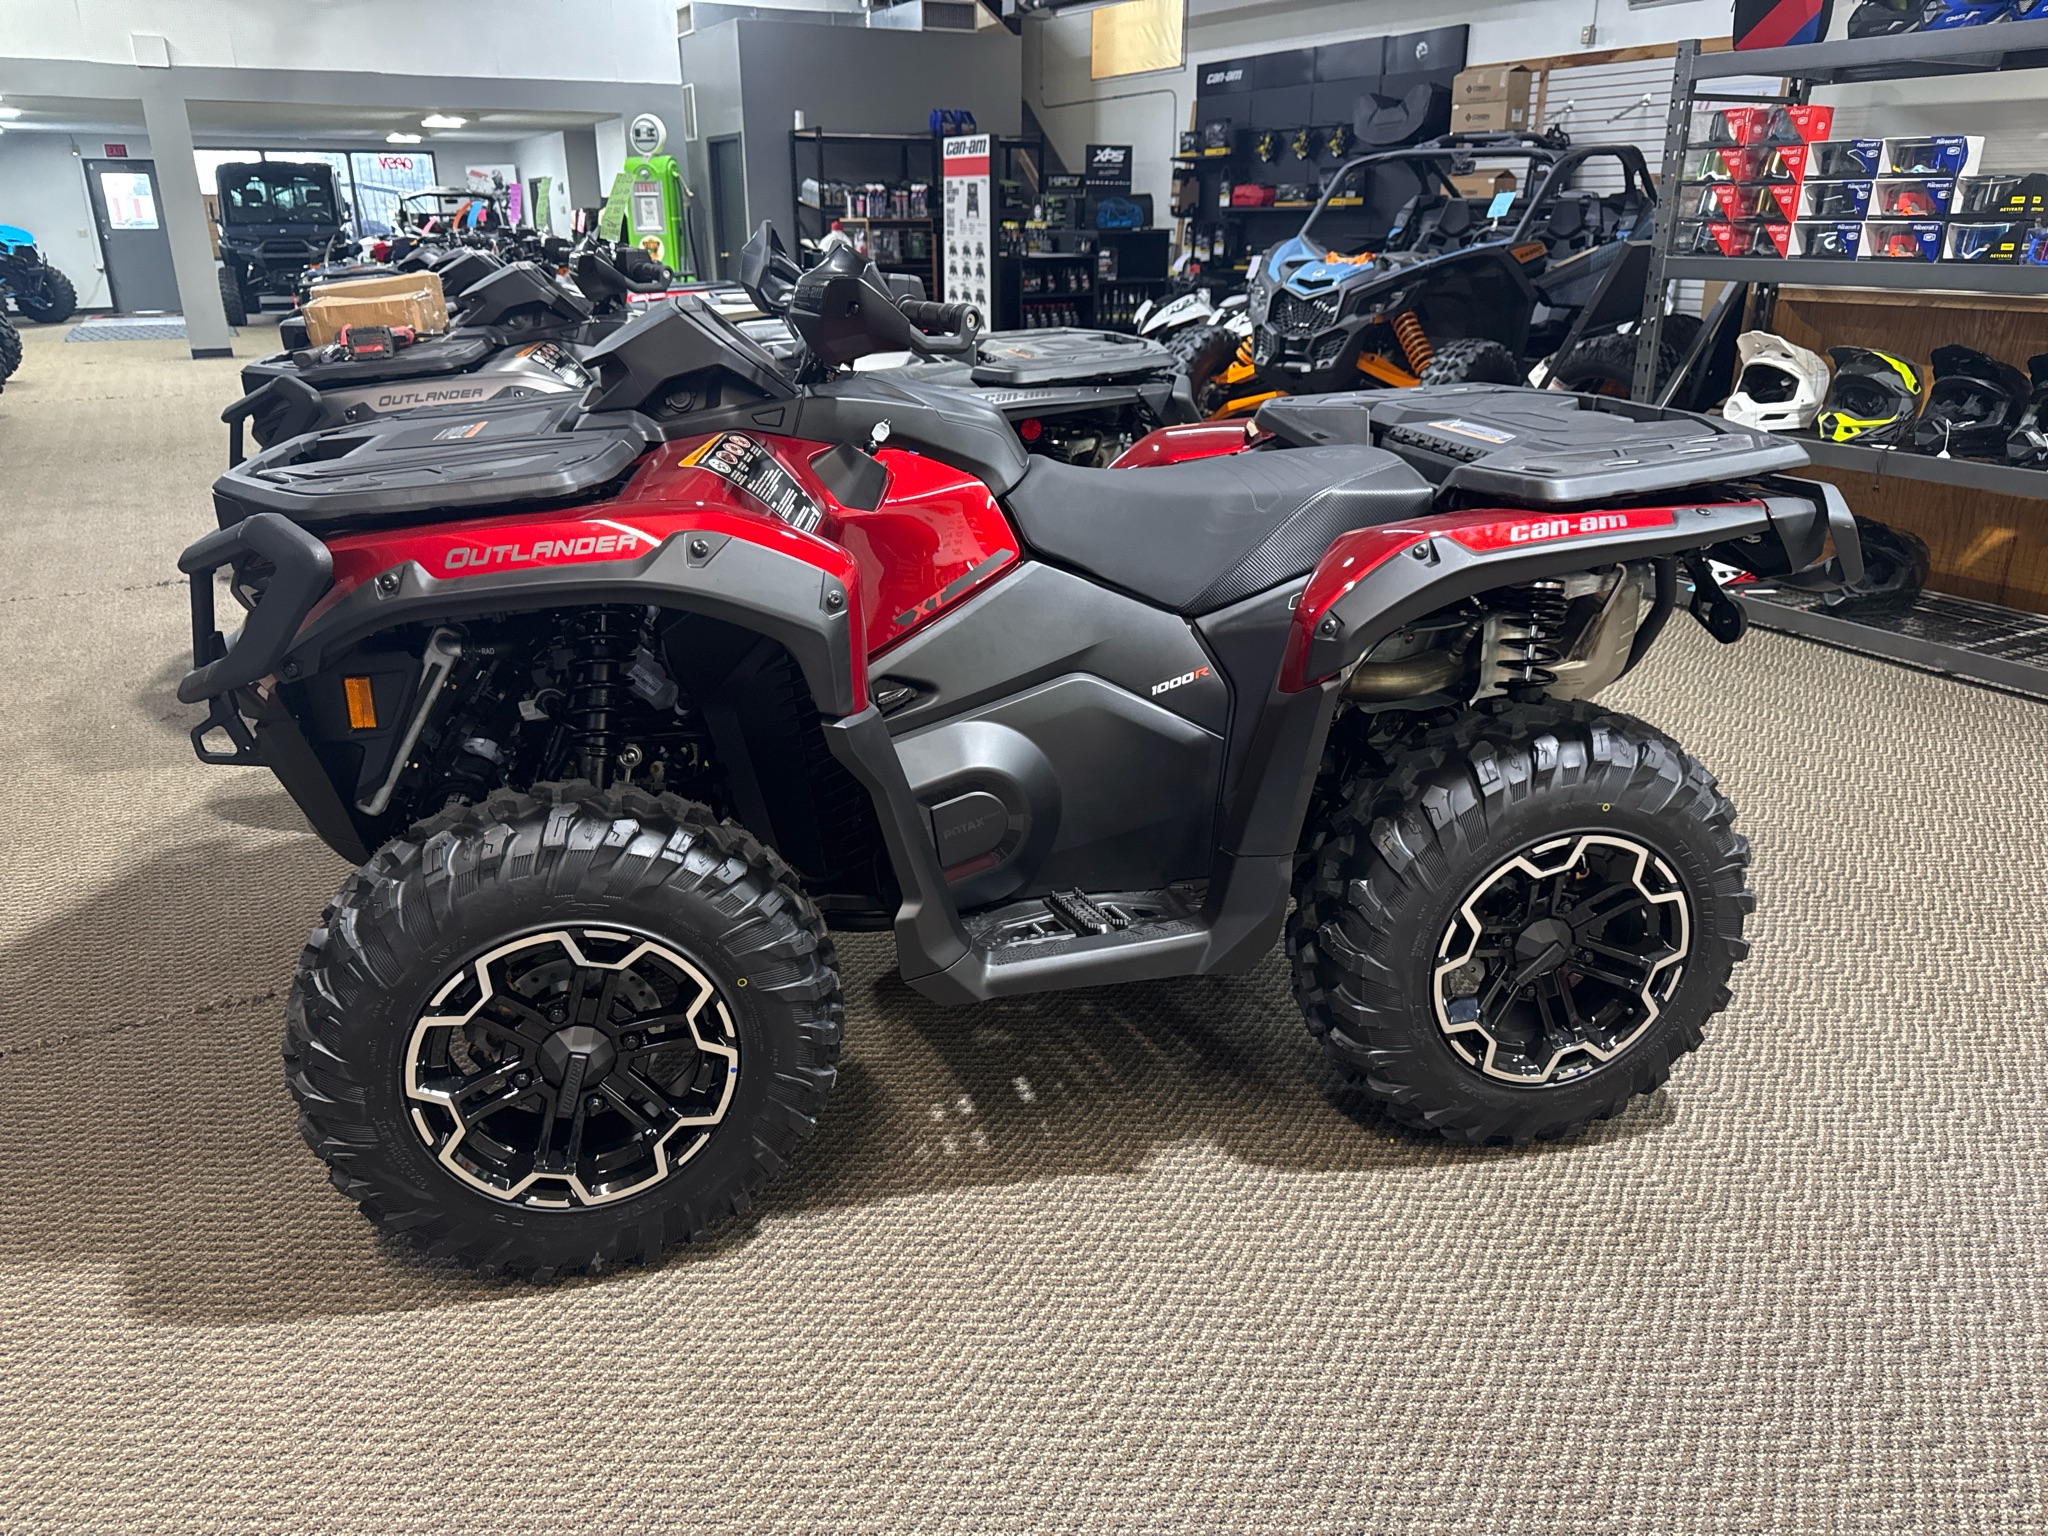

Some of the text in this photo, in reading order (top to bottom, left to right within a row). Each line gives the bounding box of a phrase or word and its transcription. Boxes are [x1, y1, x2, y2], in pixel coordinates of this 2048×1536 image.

[1206, 69, 1243, 85] can-am
[107, 146, 126, 156] EXIT
[945, 139, 987, 156] can-am
[1092, 147, 1126, 163] XPS
[378, 388, 484, 407] OUTLANDER
[1509, 514, 1628, 542] can-am
[444, 533, 639, 570] OUTLANDER
[912, 586, 947, 622] XT
[1151, 666, 1210, 696] 1000R
